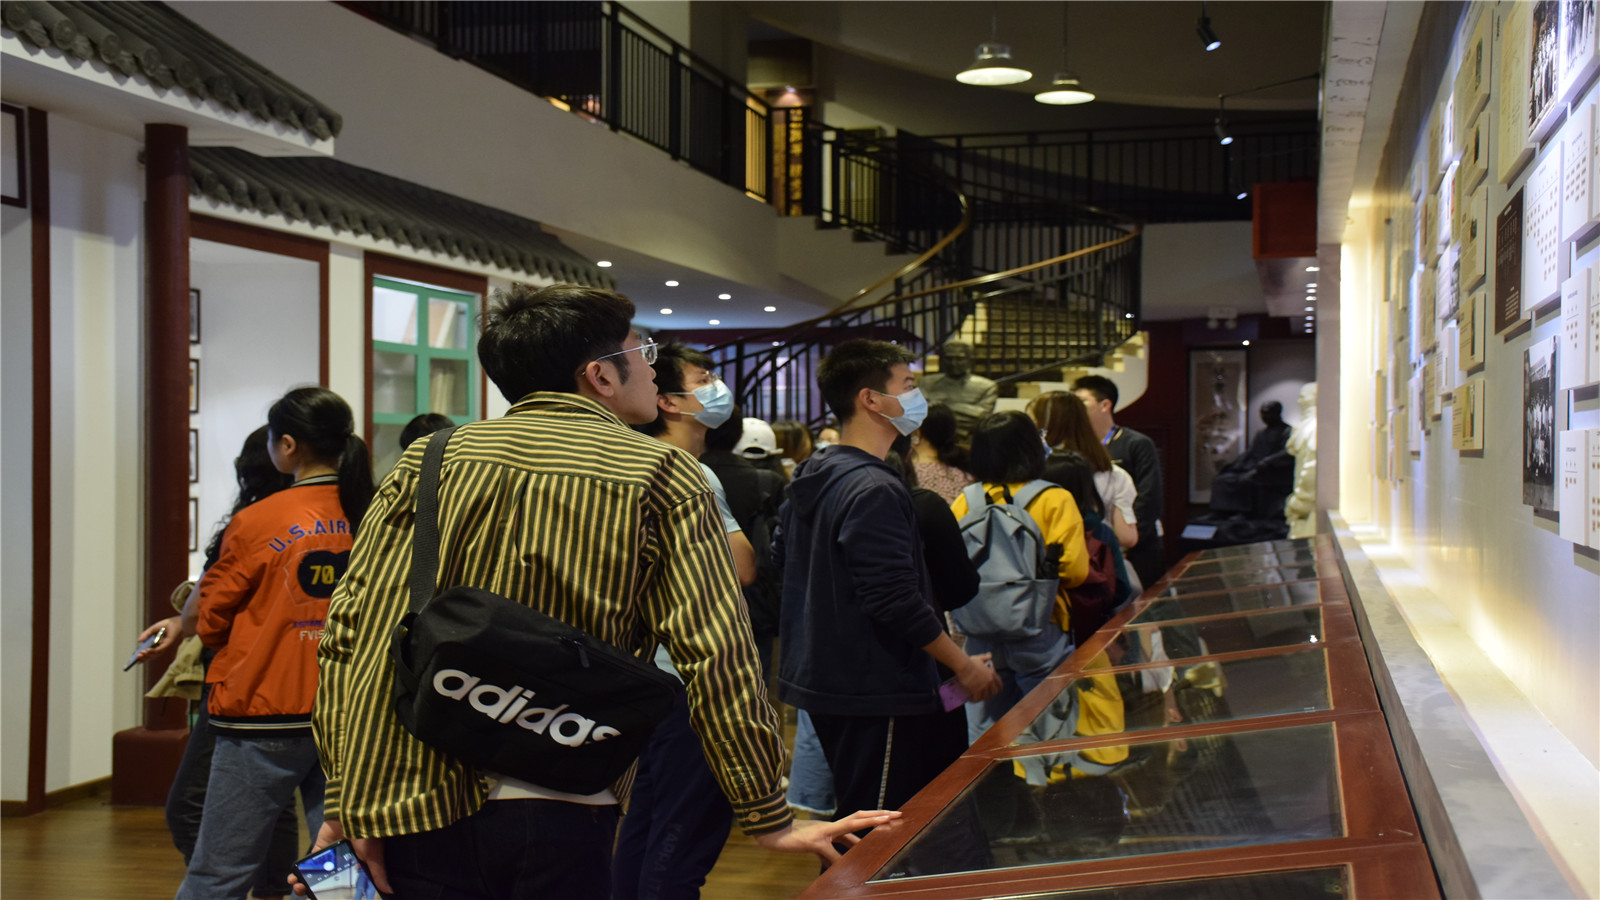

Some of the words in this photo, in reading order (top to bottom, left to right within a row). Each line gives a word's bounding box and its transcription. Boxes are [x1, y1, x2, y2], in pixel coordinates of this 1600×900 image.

[269, 519, 352, 552] U.S.AIR
[309, 565, 335, 585] 70
[432, 668, 622, 747] adidas
